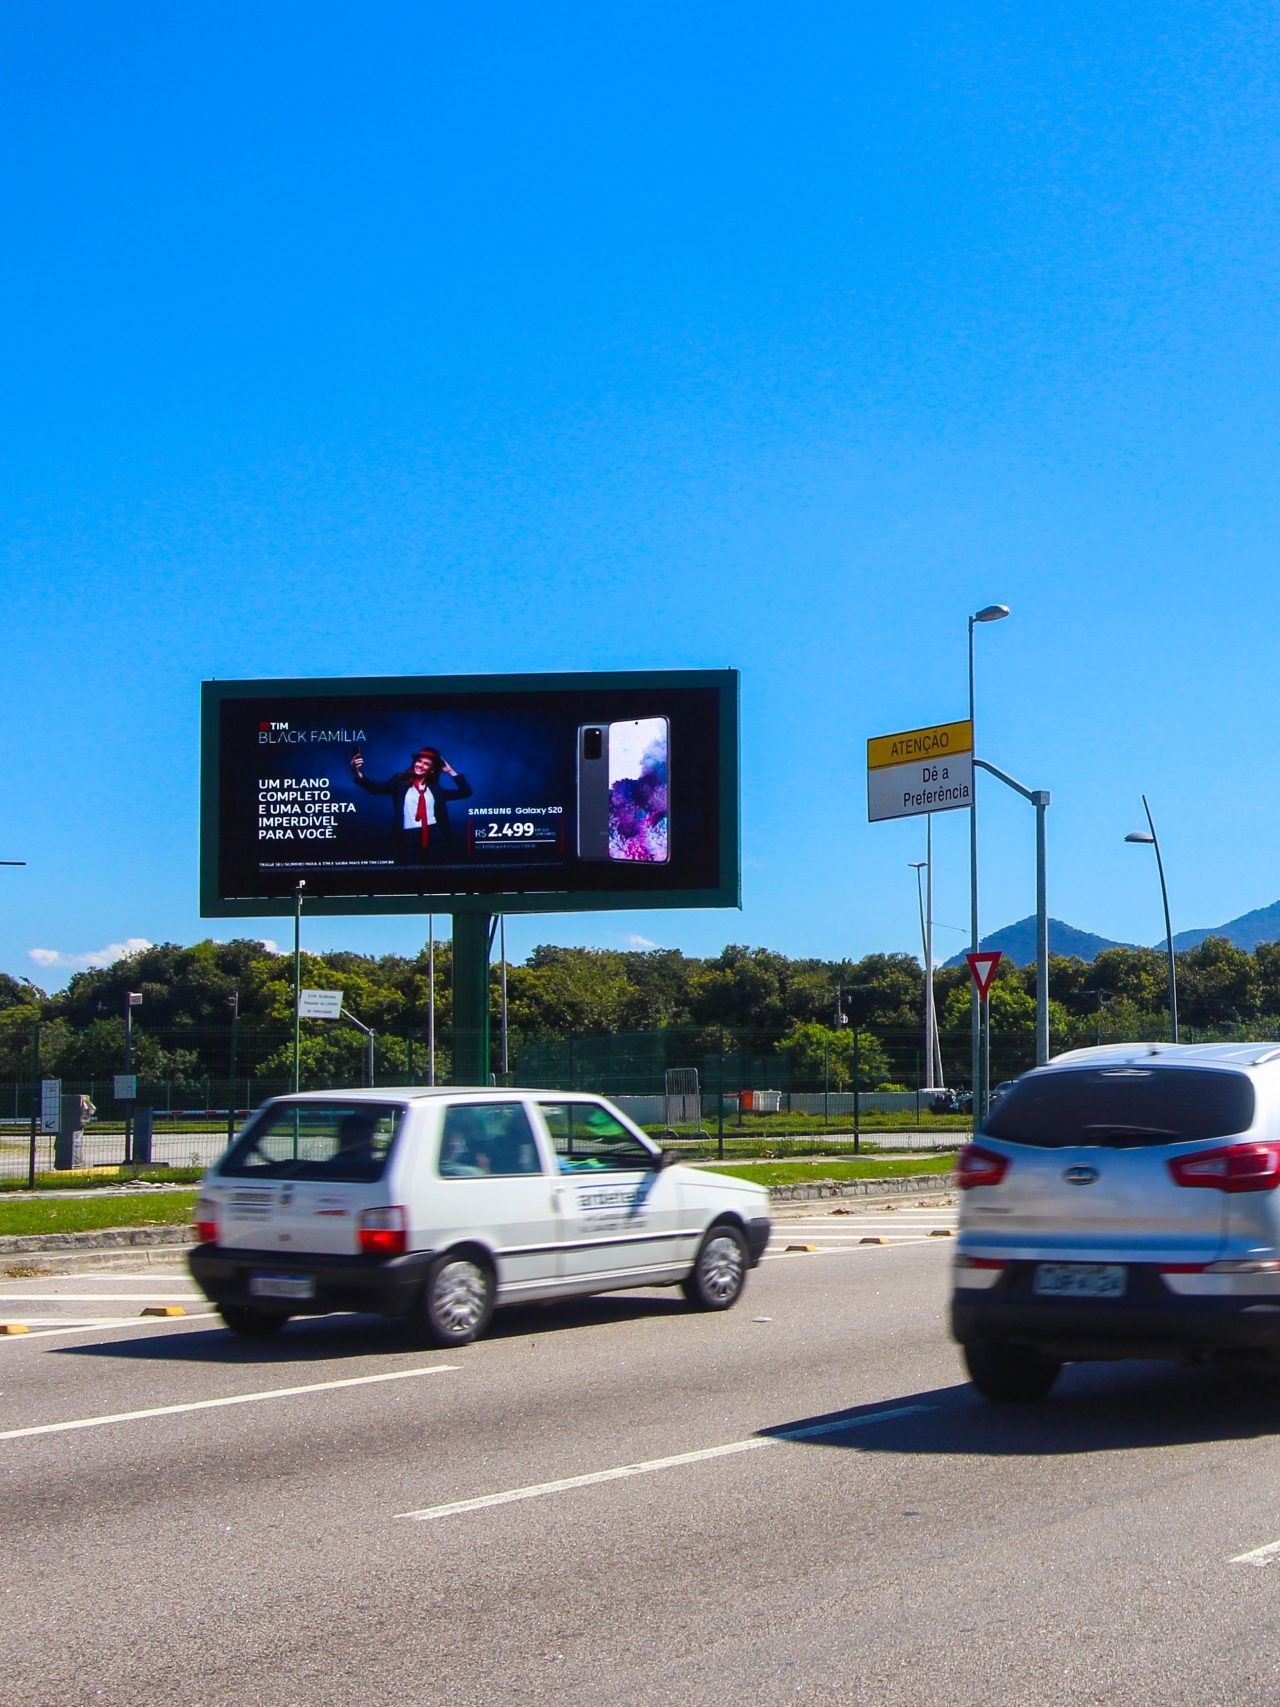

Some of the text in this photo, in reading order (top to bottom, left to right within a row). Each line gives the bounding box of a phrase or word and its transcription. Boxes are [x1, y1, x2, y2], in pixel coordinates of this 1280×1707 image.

[270, 722, 289, 730] TIM
[258, 728, 367, 744] BLACK FAMÍLIA
[890, 731, 949, 757] ATENÇÃO
[922, 766, 949, 782] Dê a
[259, 778, 330, 789] UM PLANO
[258, 791, 331, 802] COMPLETO
[903, 783, 969, 807] Preferência
[259, 803, 357, 814] E UMA OFERTA
[468, 806, 563, 816] SAMSUNG Galaxy S20
[259, 814, 339, 827] IMPERDÍVEL
[259, 826, 337, 840] PARA VOCÊ.
[475, 828, 487, 838] R$
[488, 822, 535, 838] 2.499
